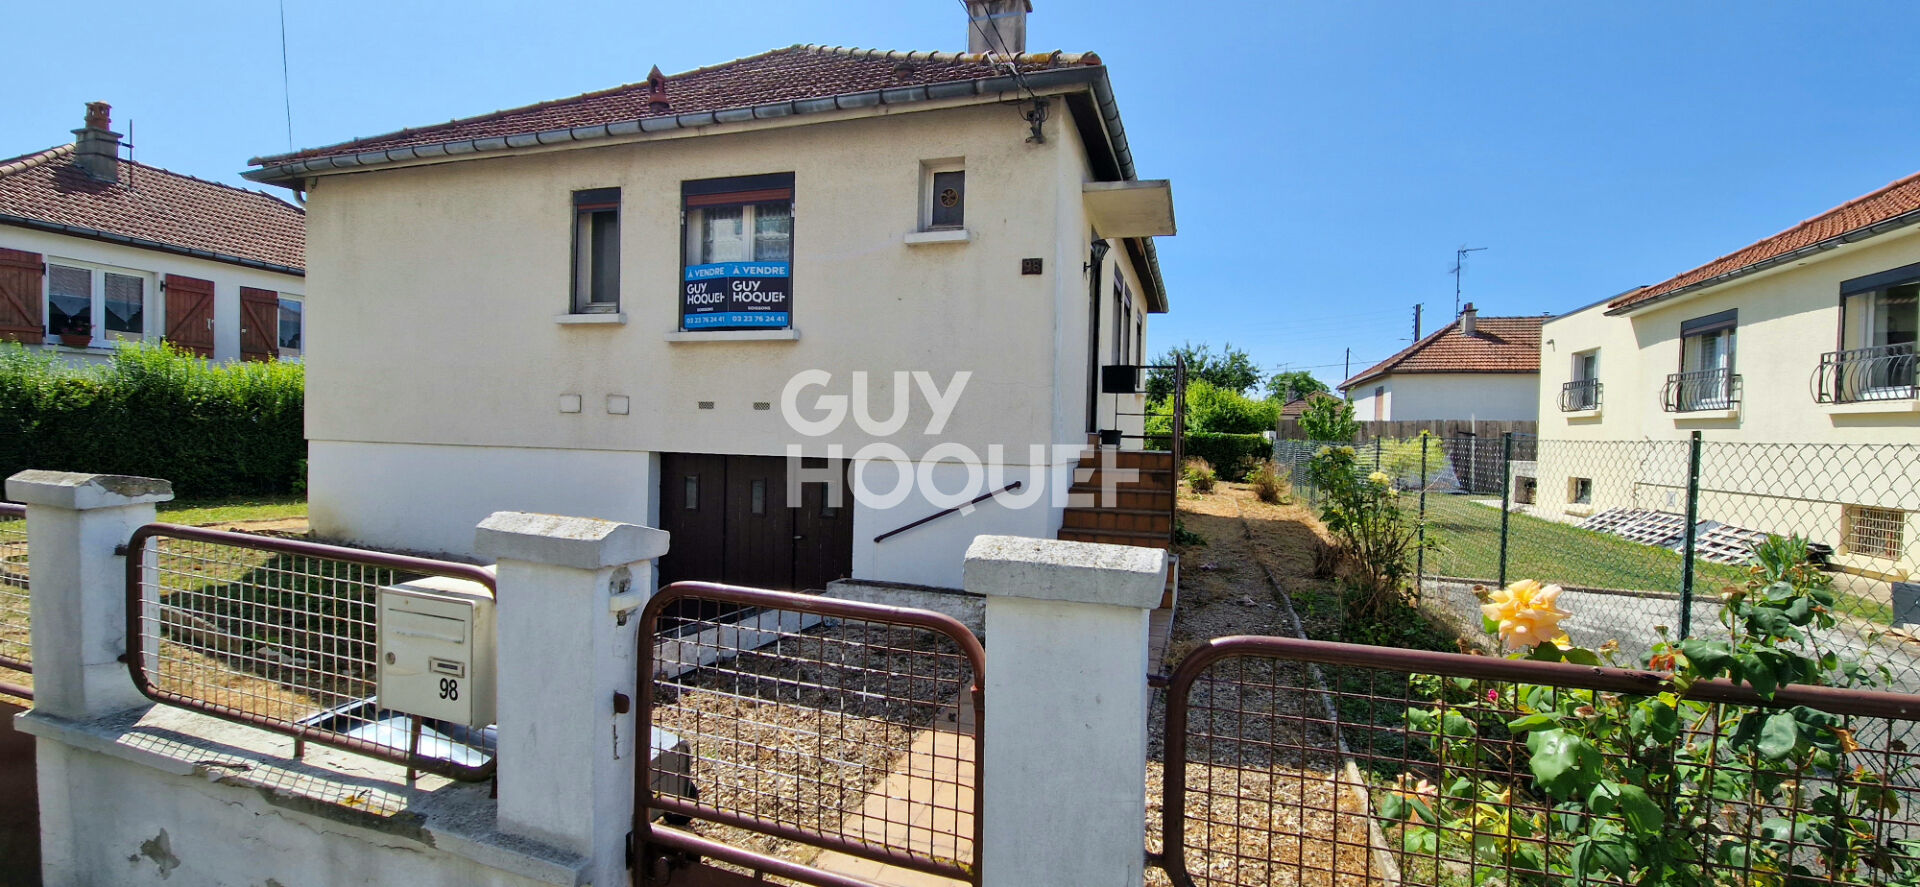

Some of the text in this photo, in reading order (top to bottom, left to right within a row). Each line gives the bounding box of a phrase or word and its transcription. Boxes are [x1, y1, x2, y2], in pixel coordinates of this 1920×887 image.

[695, 267, 725, 277] VENDRE
[732, 265, 785, 275] À VENDRE
[687, 283, 707, 294] GUY
[732, 280, 761, 292] GUY
[732, 291, 785, 303] HOQUET
[439, 677, 459, 701] 98
